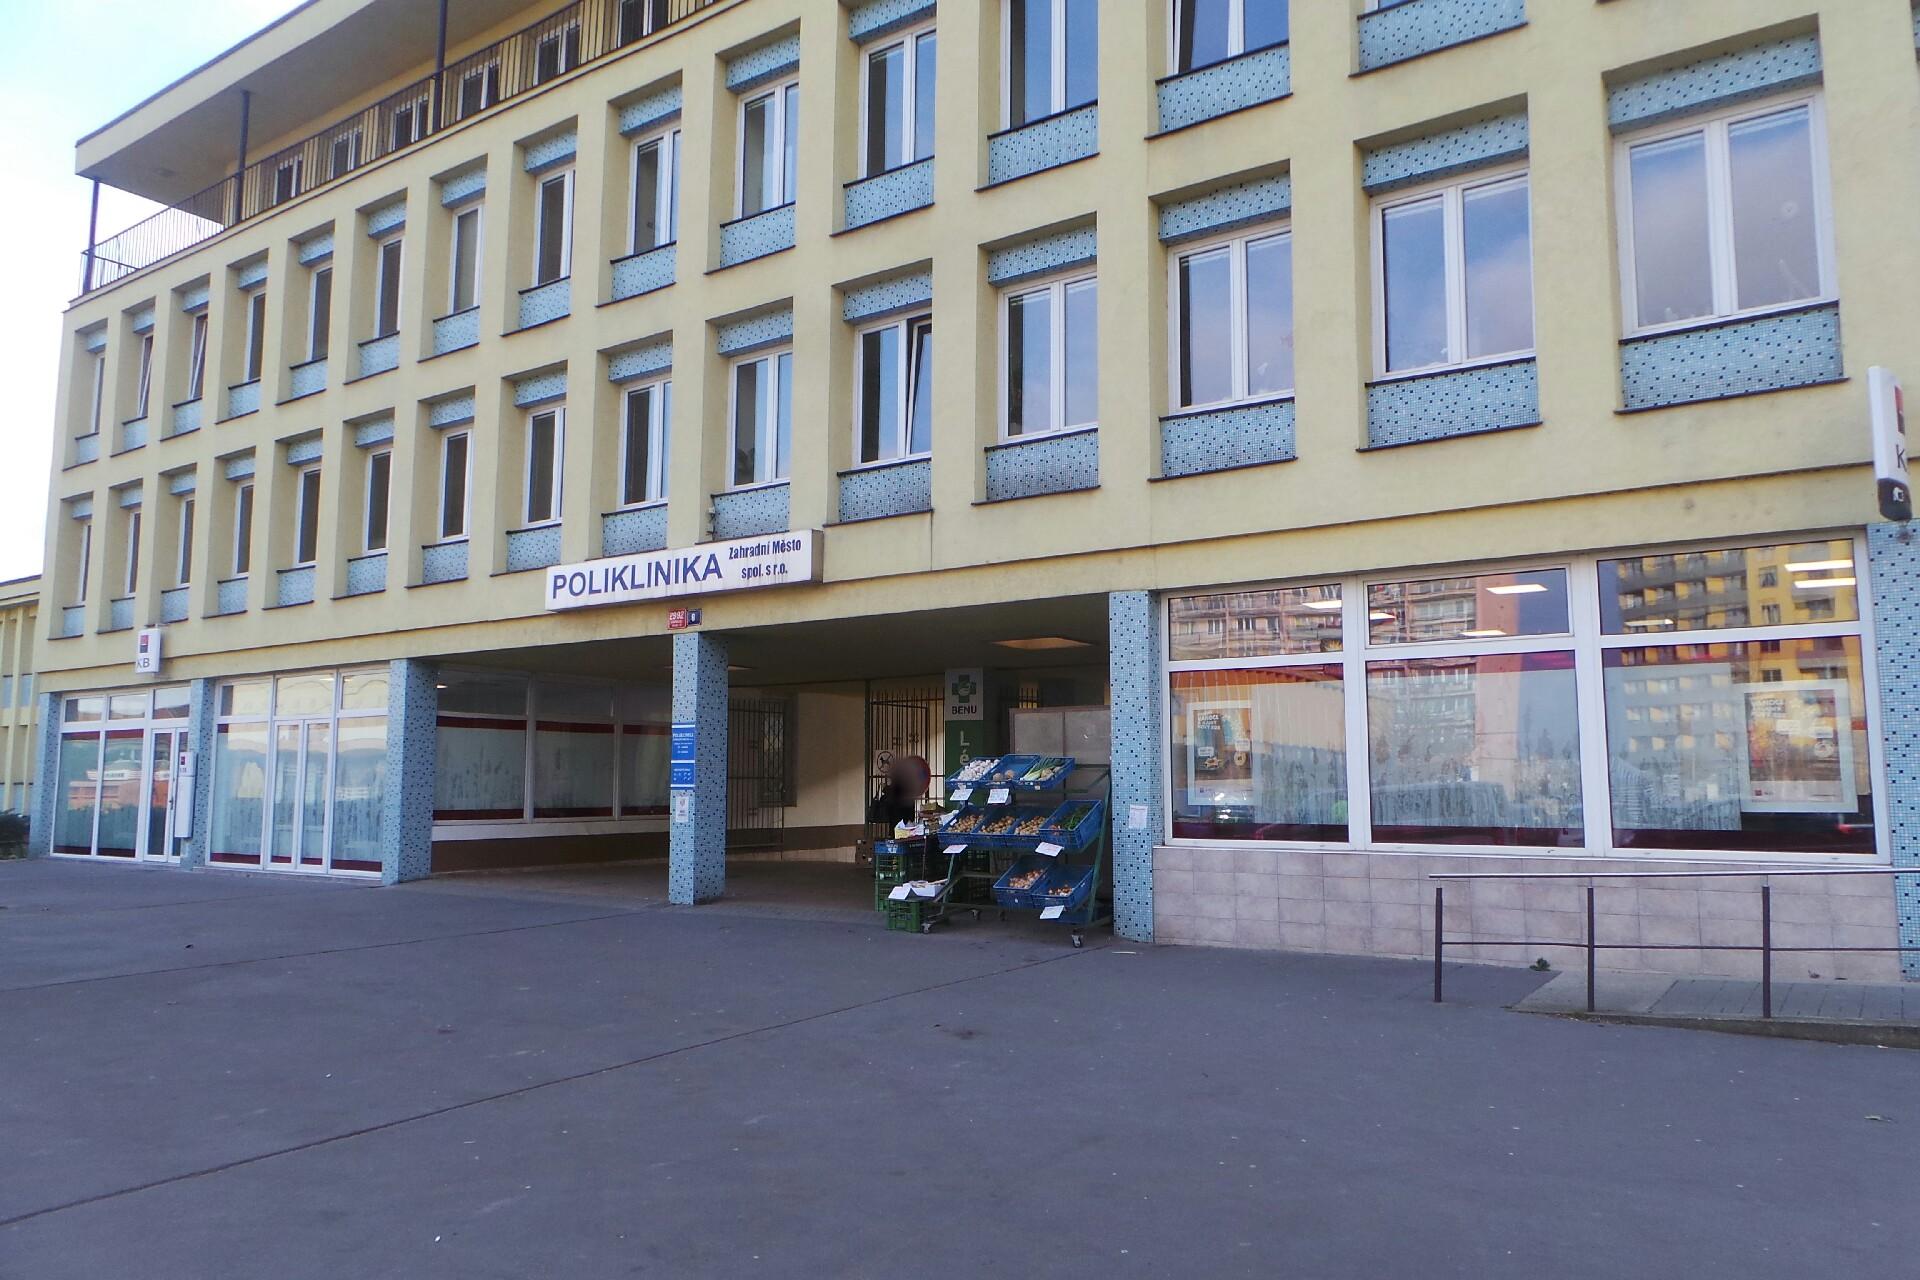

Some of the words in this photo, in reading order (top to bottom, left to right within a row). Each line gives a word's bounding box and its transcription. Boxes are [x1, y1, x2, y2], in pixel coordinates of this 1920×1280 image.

[729, 541, 770, 560] Zahradní
[772, 539, 802, 555] Město
[552, 553, 723, 599] POLIKLINIKA
[741, 563, 764, 580] spol.
[765, 564, 771, 576] s
[773, 563, 788, 576] r.o.
[951, 705, 977, 715] BENU
